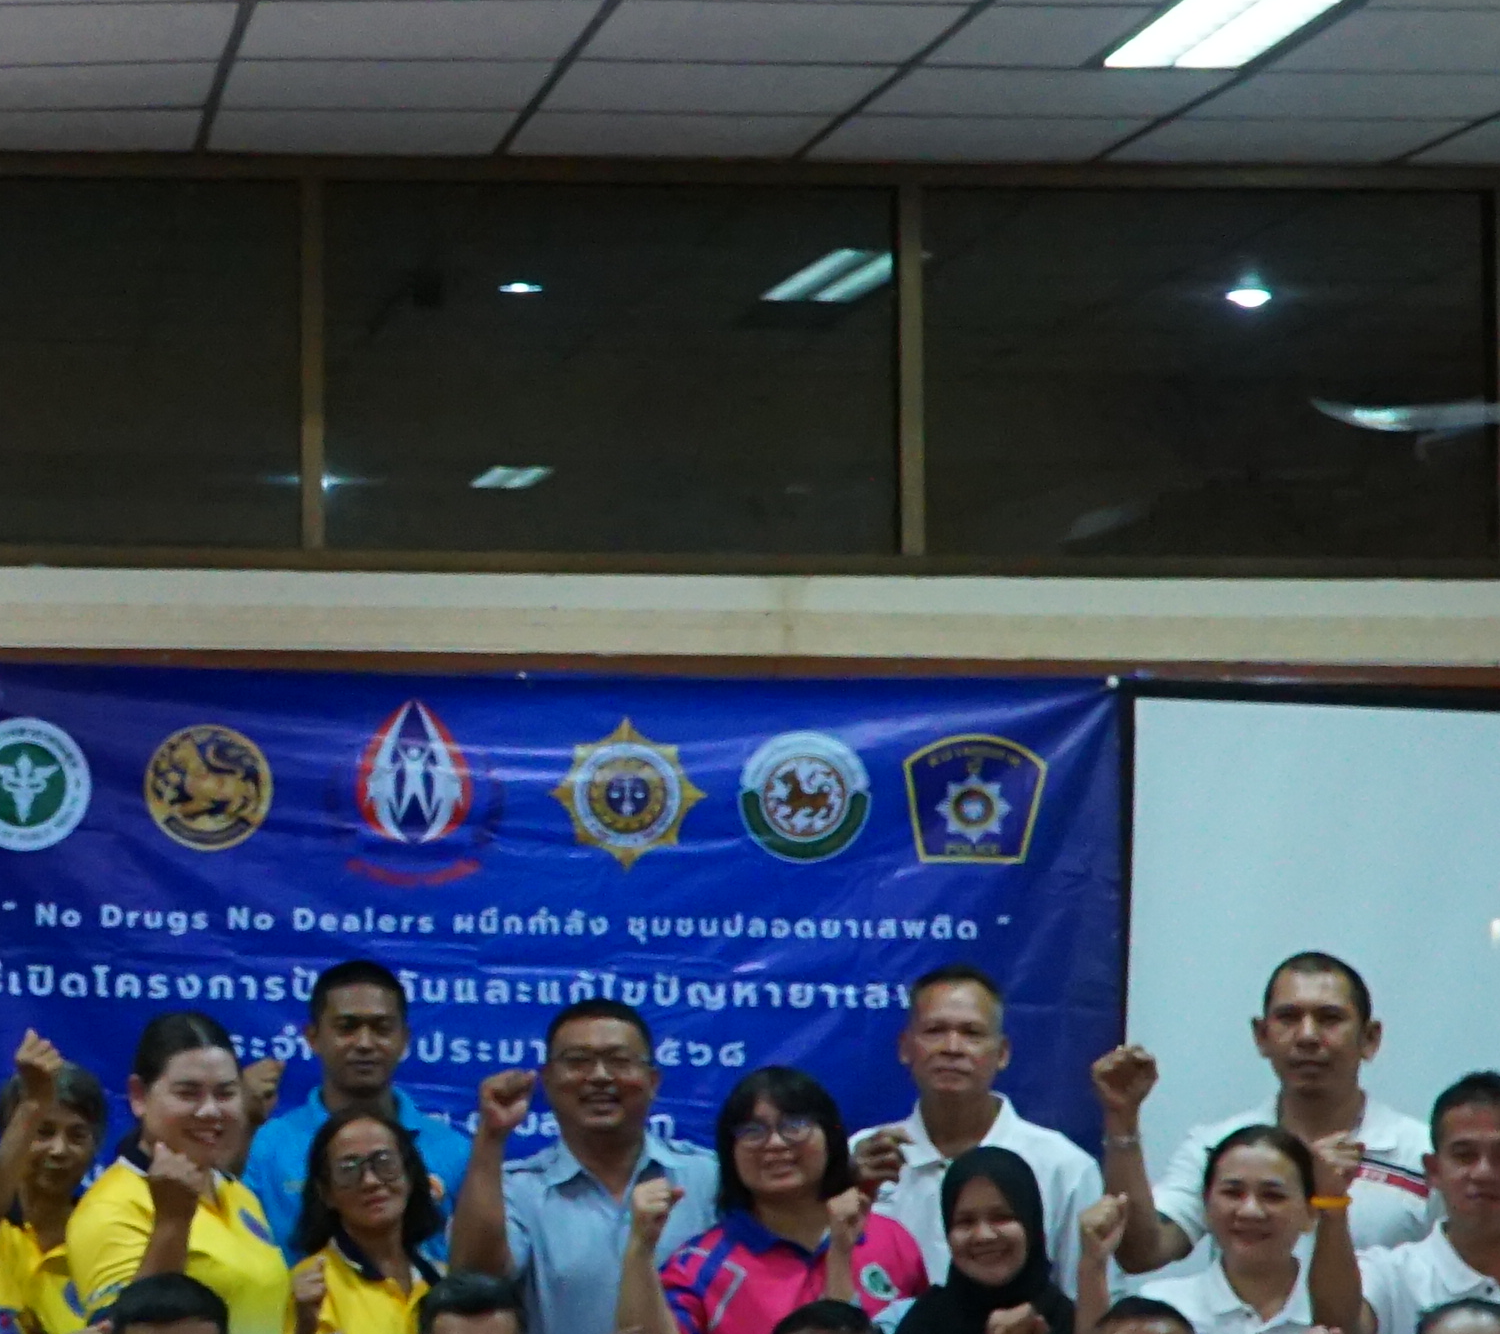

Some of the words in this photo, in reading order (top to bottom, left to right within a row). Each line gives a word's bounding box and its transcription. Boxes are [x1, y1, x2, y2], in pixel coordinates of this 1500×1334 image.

[35, 901, 82, 929] No
[100, 904, 210, 937] Drugs
[227, 905, 276, 933] No
[293, 907, 436, 935] Dealers
[451, 906, 610, 937] ผนึกกำลัง
[626, 911, 979, 945] ชุมชนปลอดยาเสพติด
[654, 1039, 748, 1068] ๕๖๘
